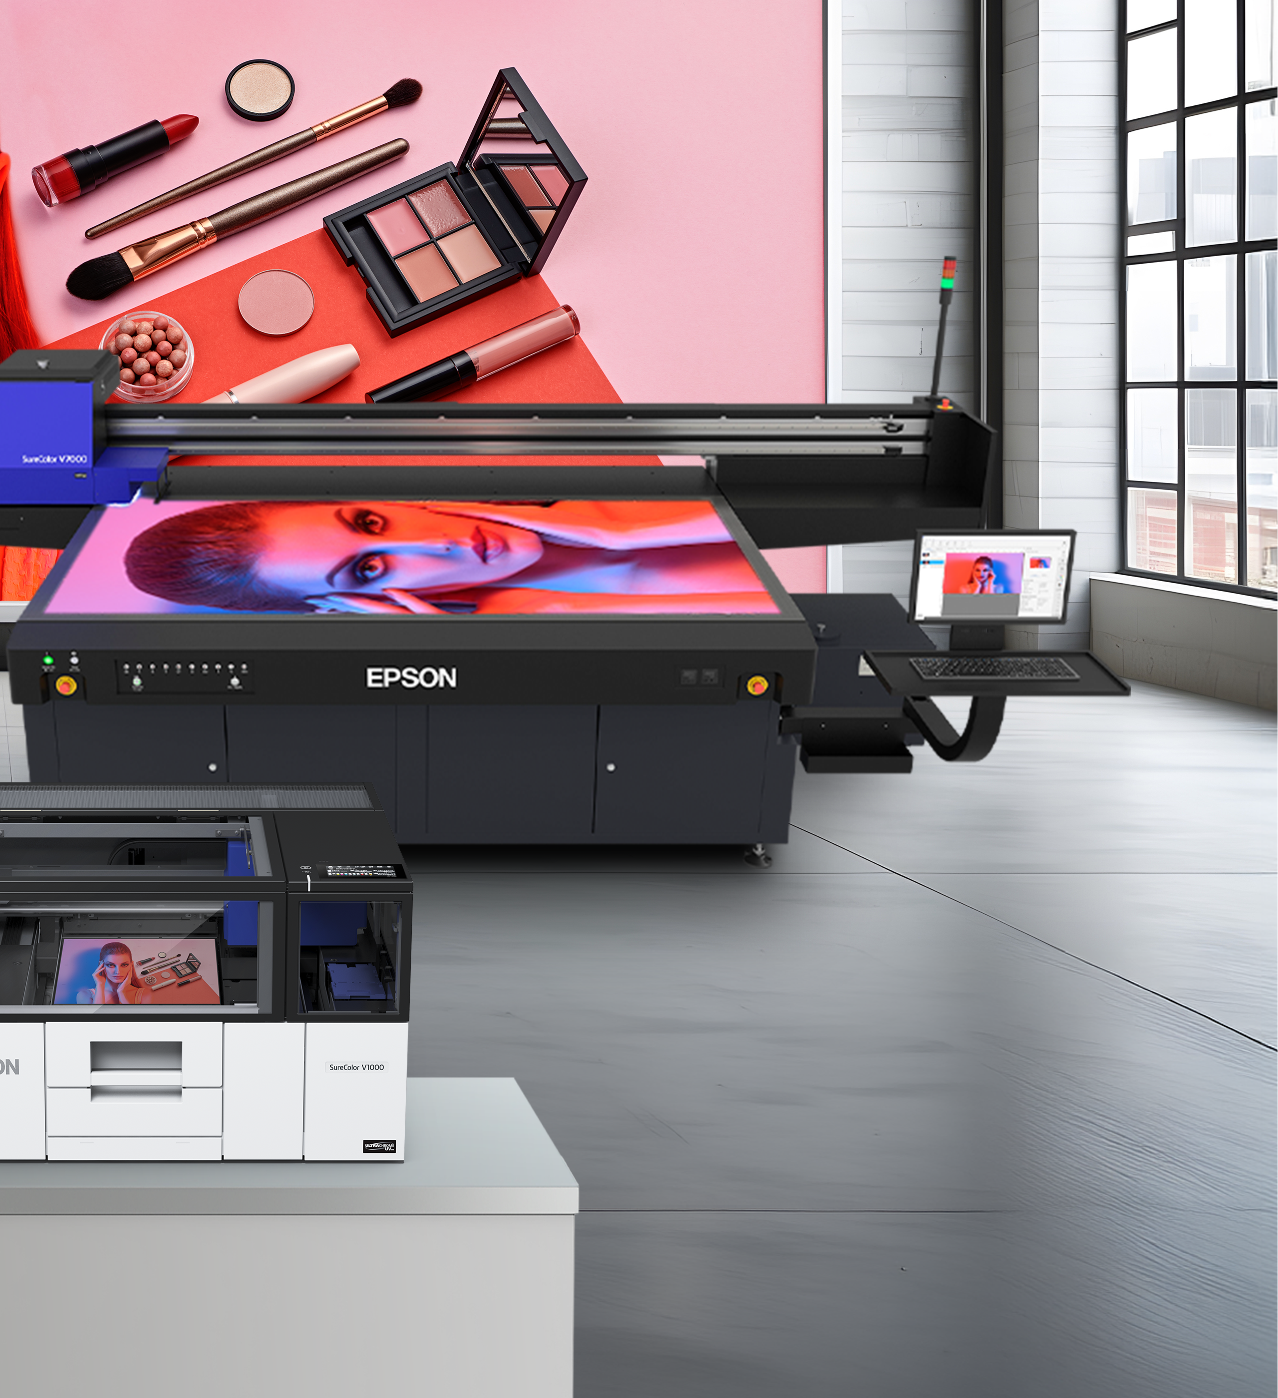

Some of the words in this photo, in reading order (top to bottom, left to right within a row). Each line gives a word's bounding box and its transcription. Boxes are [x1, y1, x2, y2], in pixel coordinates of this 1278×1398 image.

[366, 666, 457, 688] EPSON
[329, 1063, 360, 1071] SureColor
[361, 1063, 385, 1071] V1000
